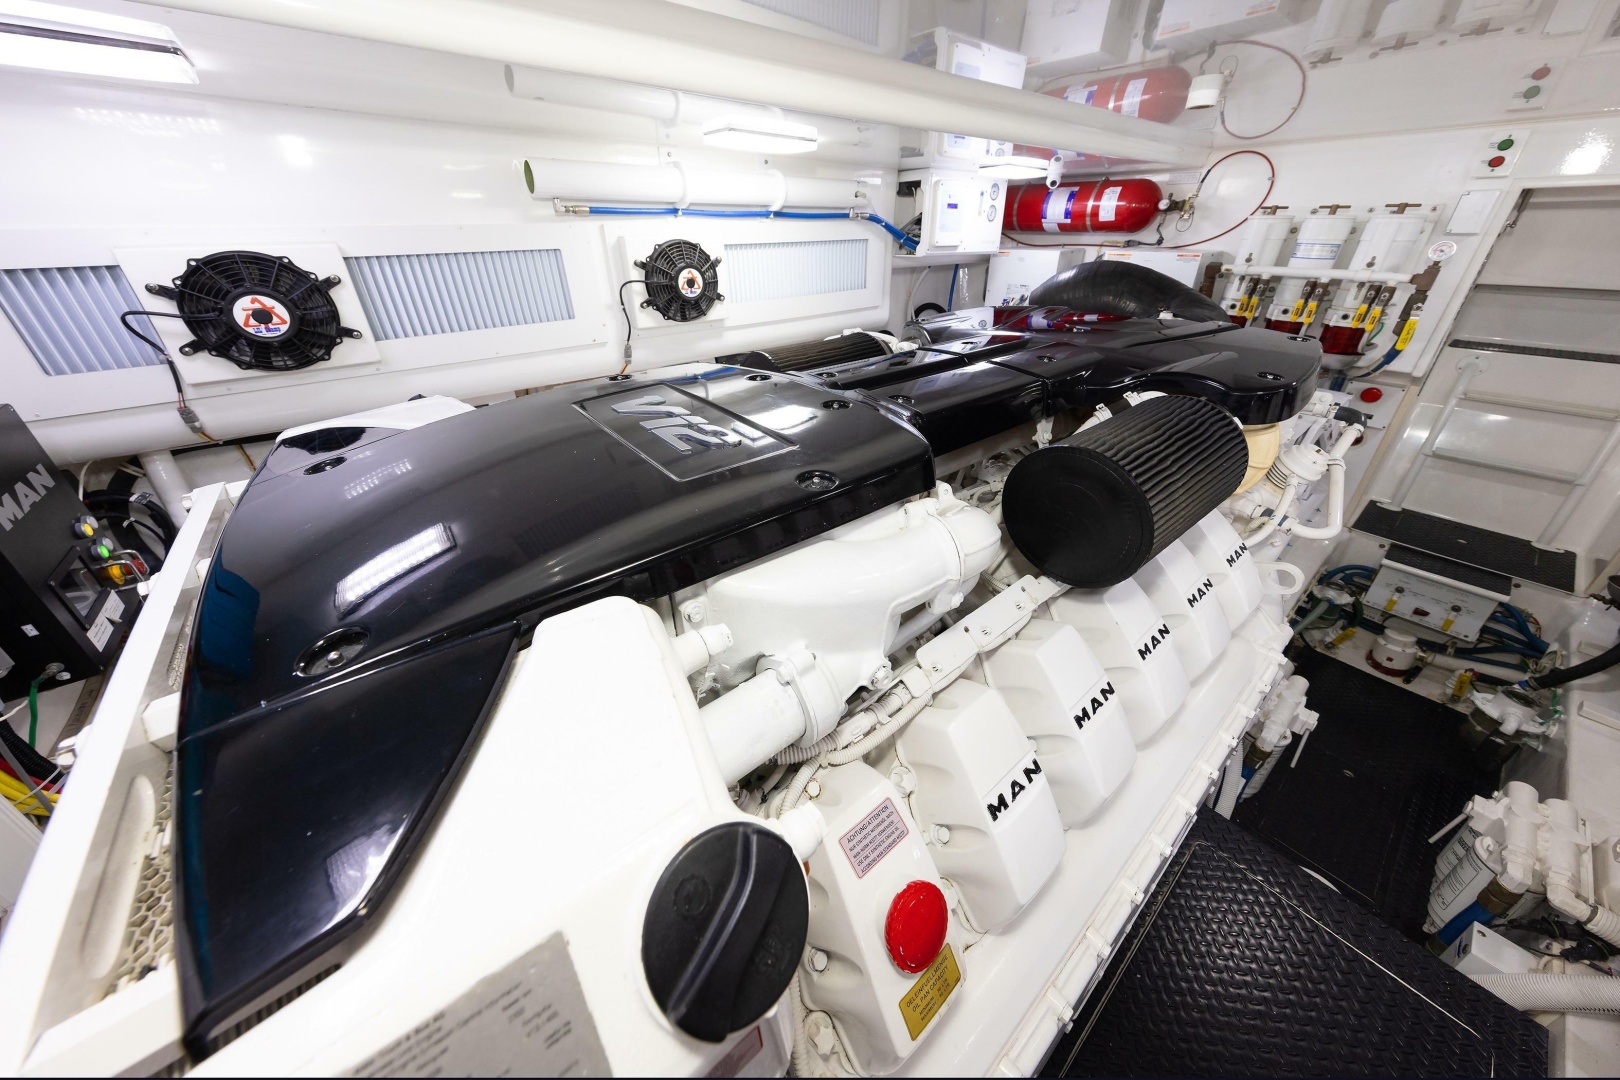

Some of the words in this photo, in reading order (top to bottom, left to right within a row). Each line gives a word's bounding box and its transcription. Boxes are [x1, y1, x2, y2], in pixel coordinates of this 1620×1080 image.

[0, 463, 56, 532] MAN
[1226, 542, 1248, 568] MAN
[1187, 578, 1214, 608] MAN
[1138, 624, 1170, 661] MAN
[1074, 681, 1115, 730] MAN
[986, 758, 1042, 822] MAN
[846, 804, 889, 844] ACHTUNG/ATTENTION
[920, 990, 930, 1003] PAN
[930, 964, 948, 991] CAPACITY
